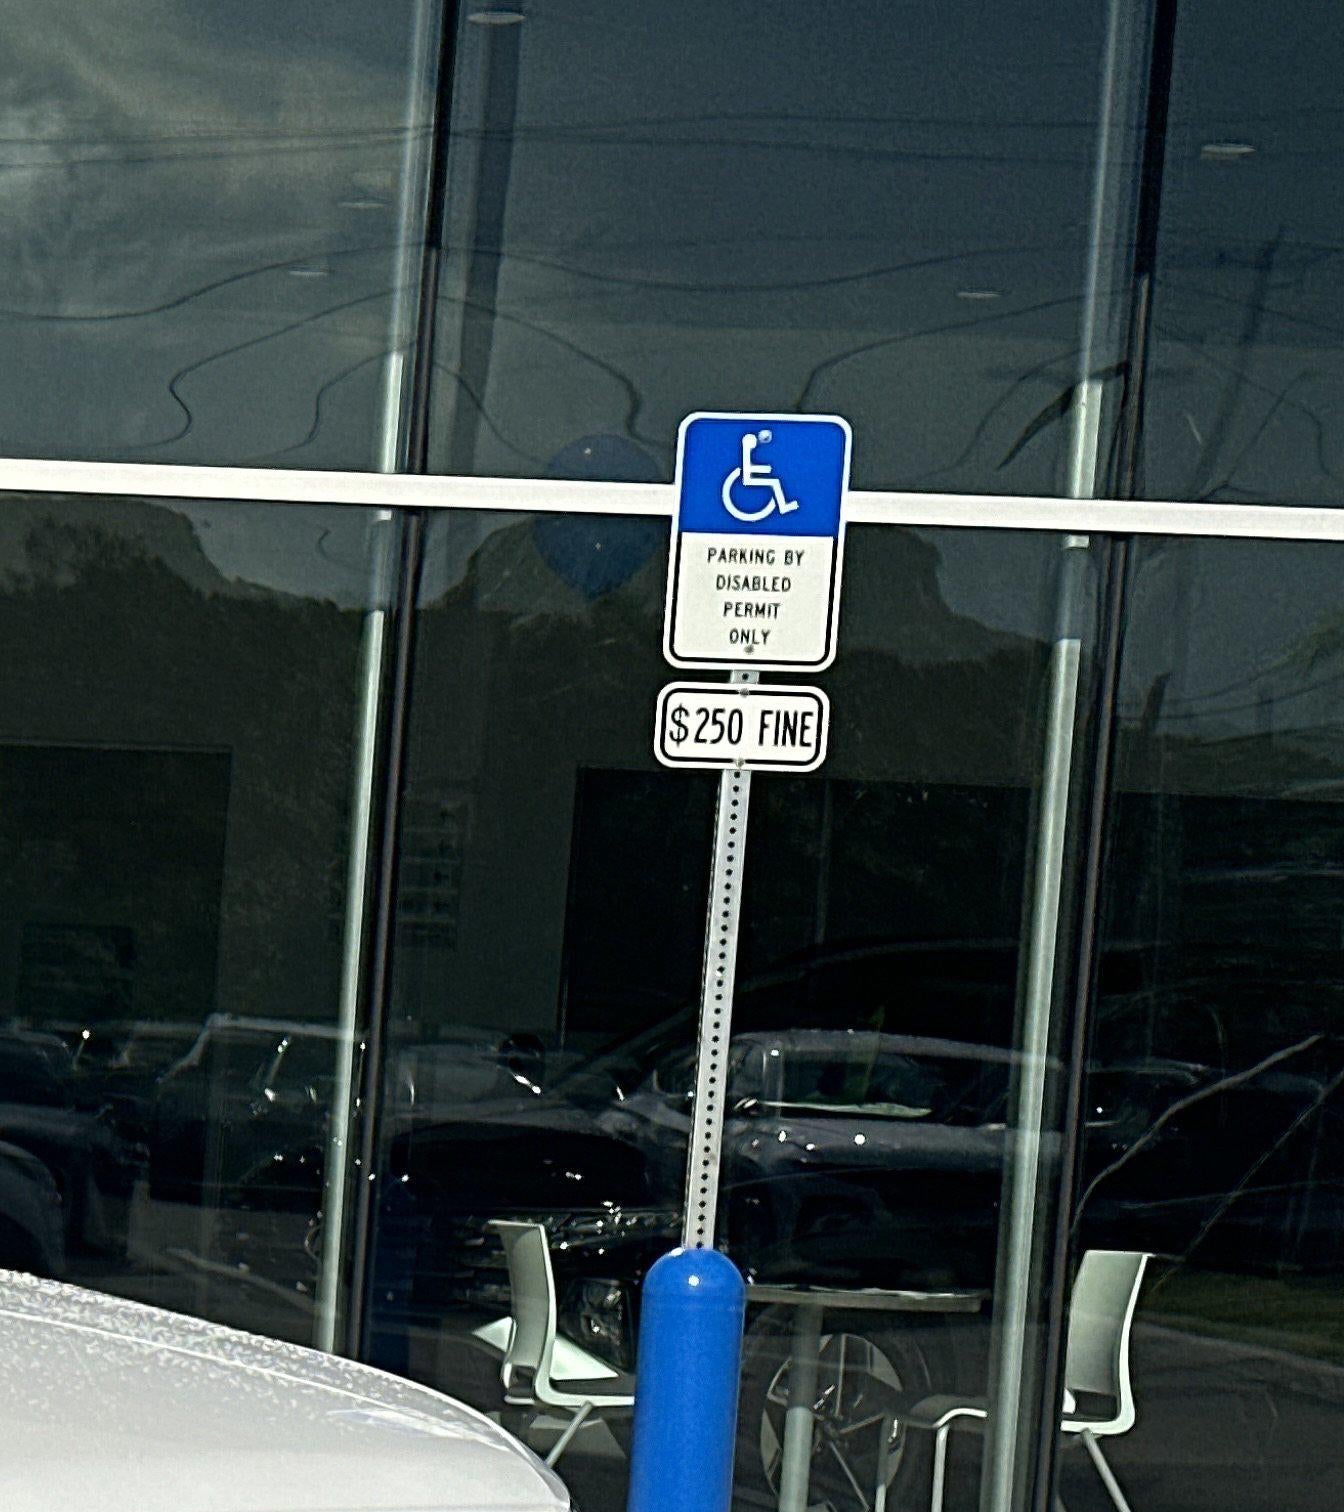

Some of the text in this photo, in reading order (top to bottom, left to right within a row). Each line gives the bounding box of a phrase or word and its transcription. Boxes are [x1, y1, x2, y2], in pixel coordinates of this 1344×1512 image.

[706, 547, 806, 567] PARKING BY
[715, 575, 792, 593] DISABLED
[722, 602, 782, 620] PERMIT
[728, 628, 772, 646] ONLY
[668, 703, 814, 748] $250 FINE
